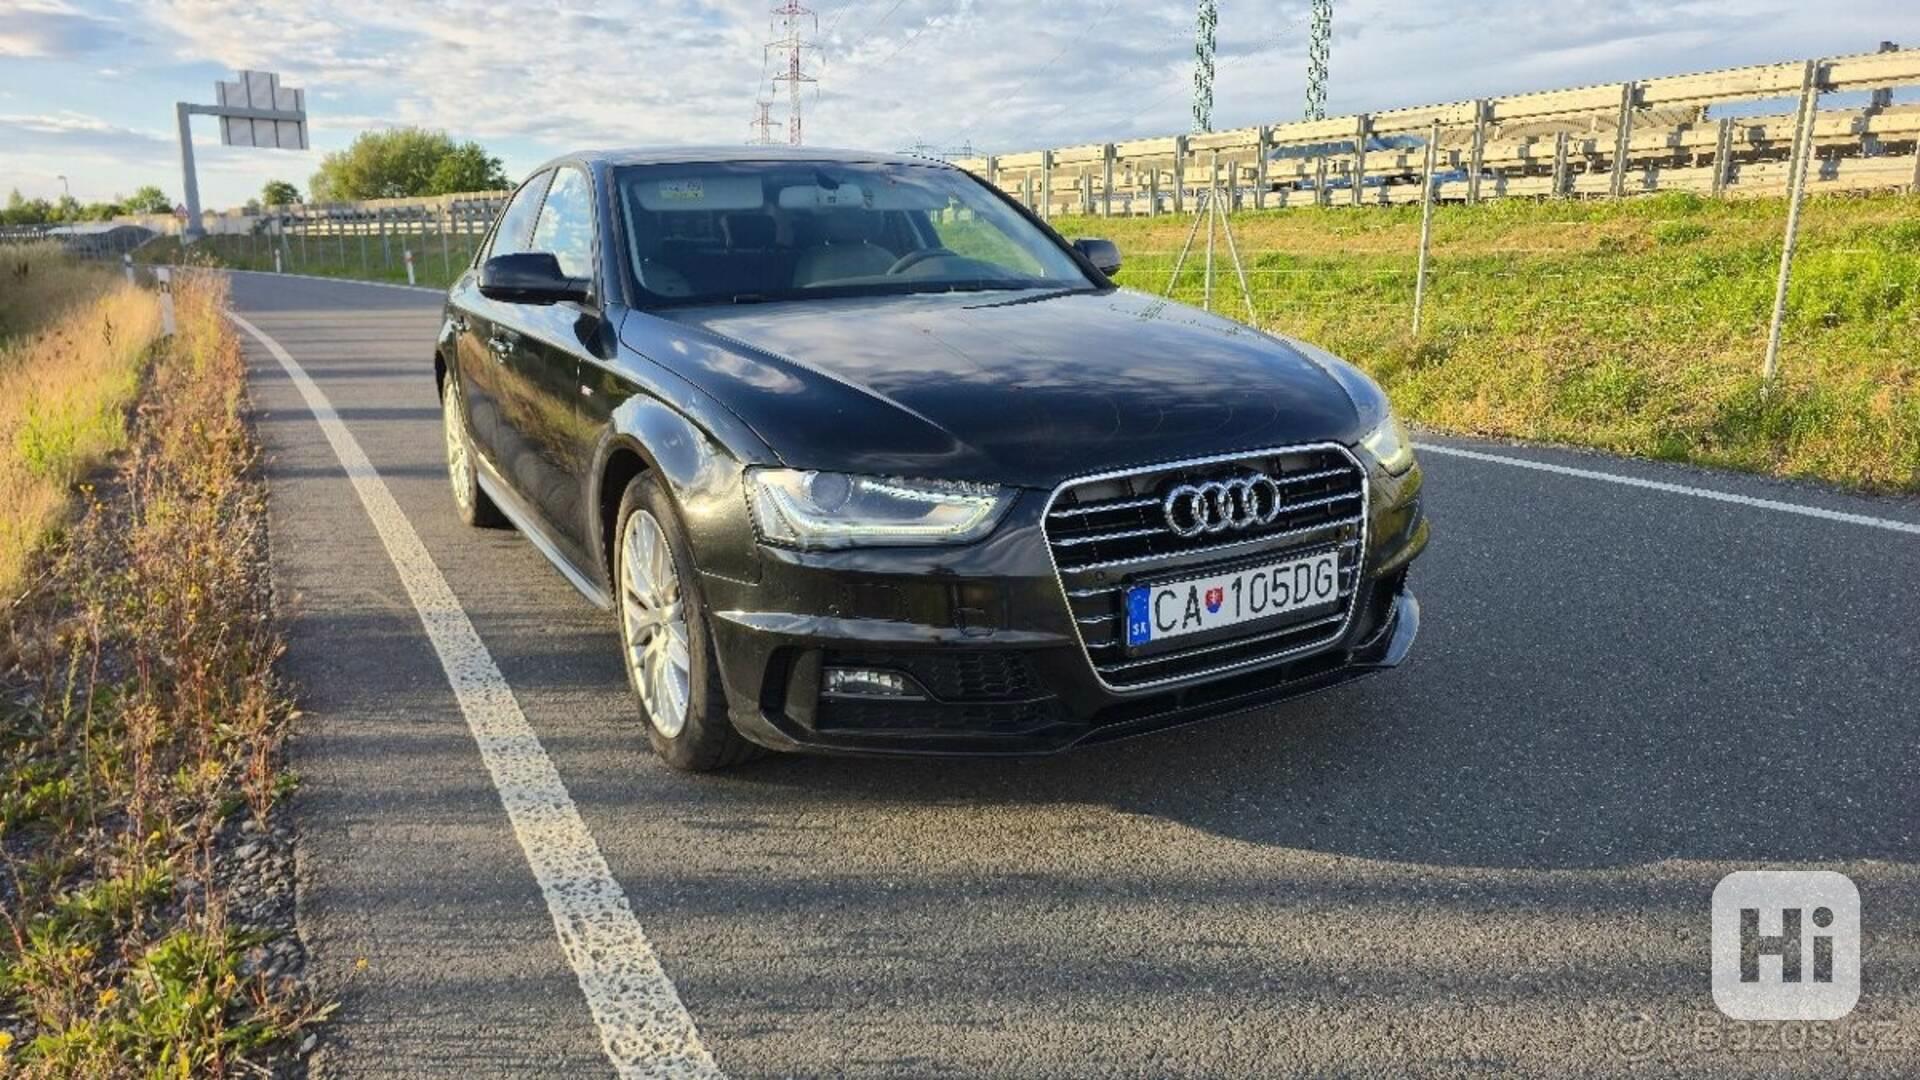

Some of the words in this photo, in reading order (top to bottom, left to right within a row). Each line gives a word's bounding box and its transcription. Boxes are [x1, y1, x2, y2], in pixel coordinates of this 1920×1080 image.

[1154, 584, 1202, 632] CA
[1231, 558, 1333, 618] 105DG
[1132, 622, 1147, 636] SK
